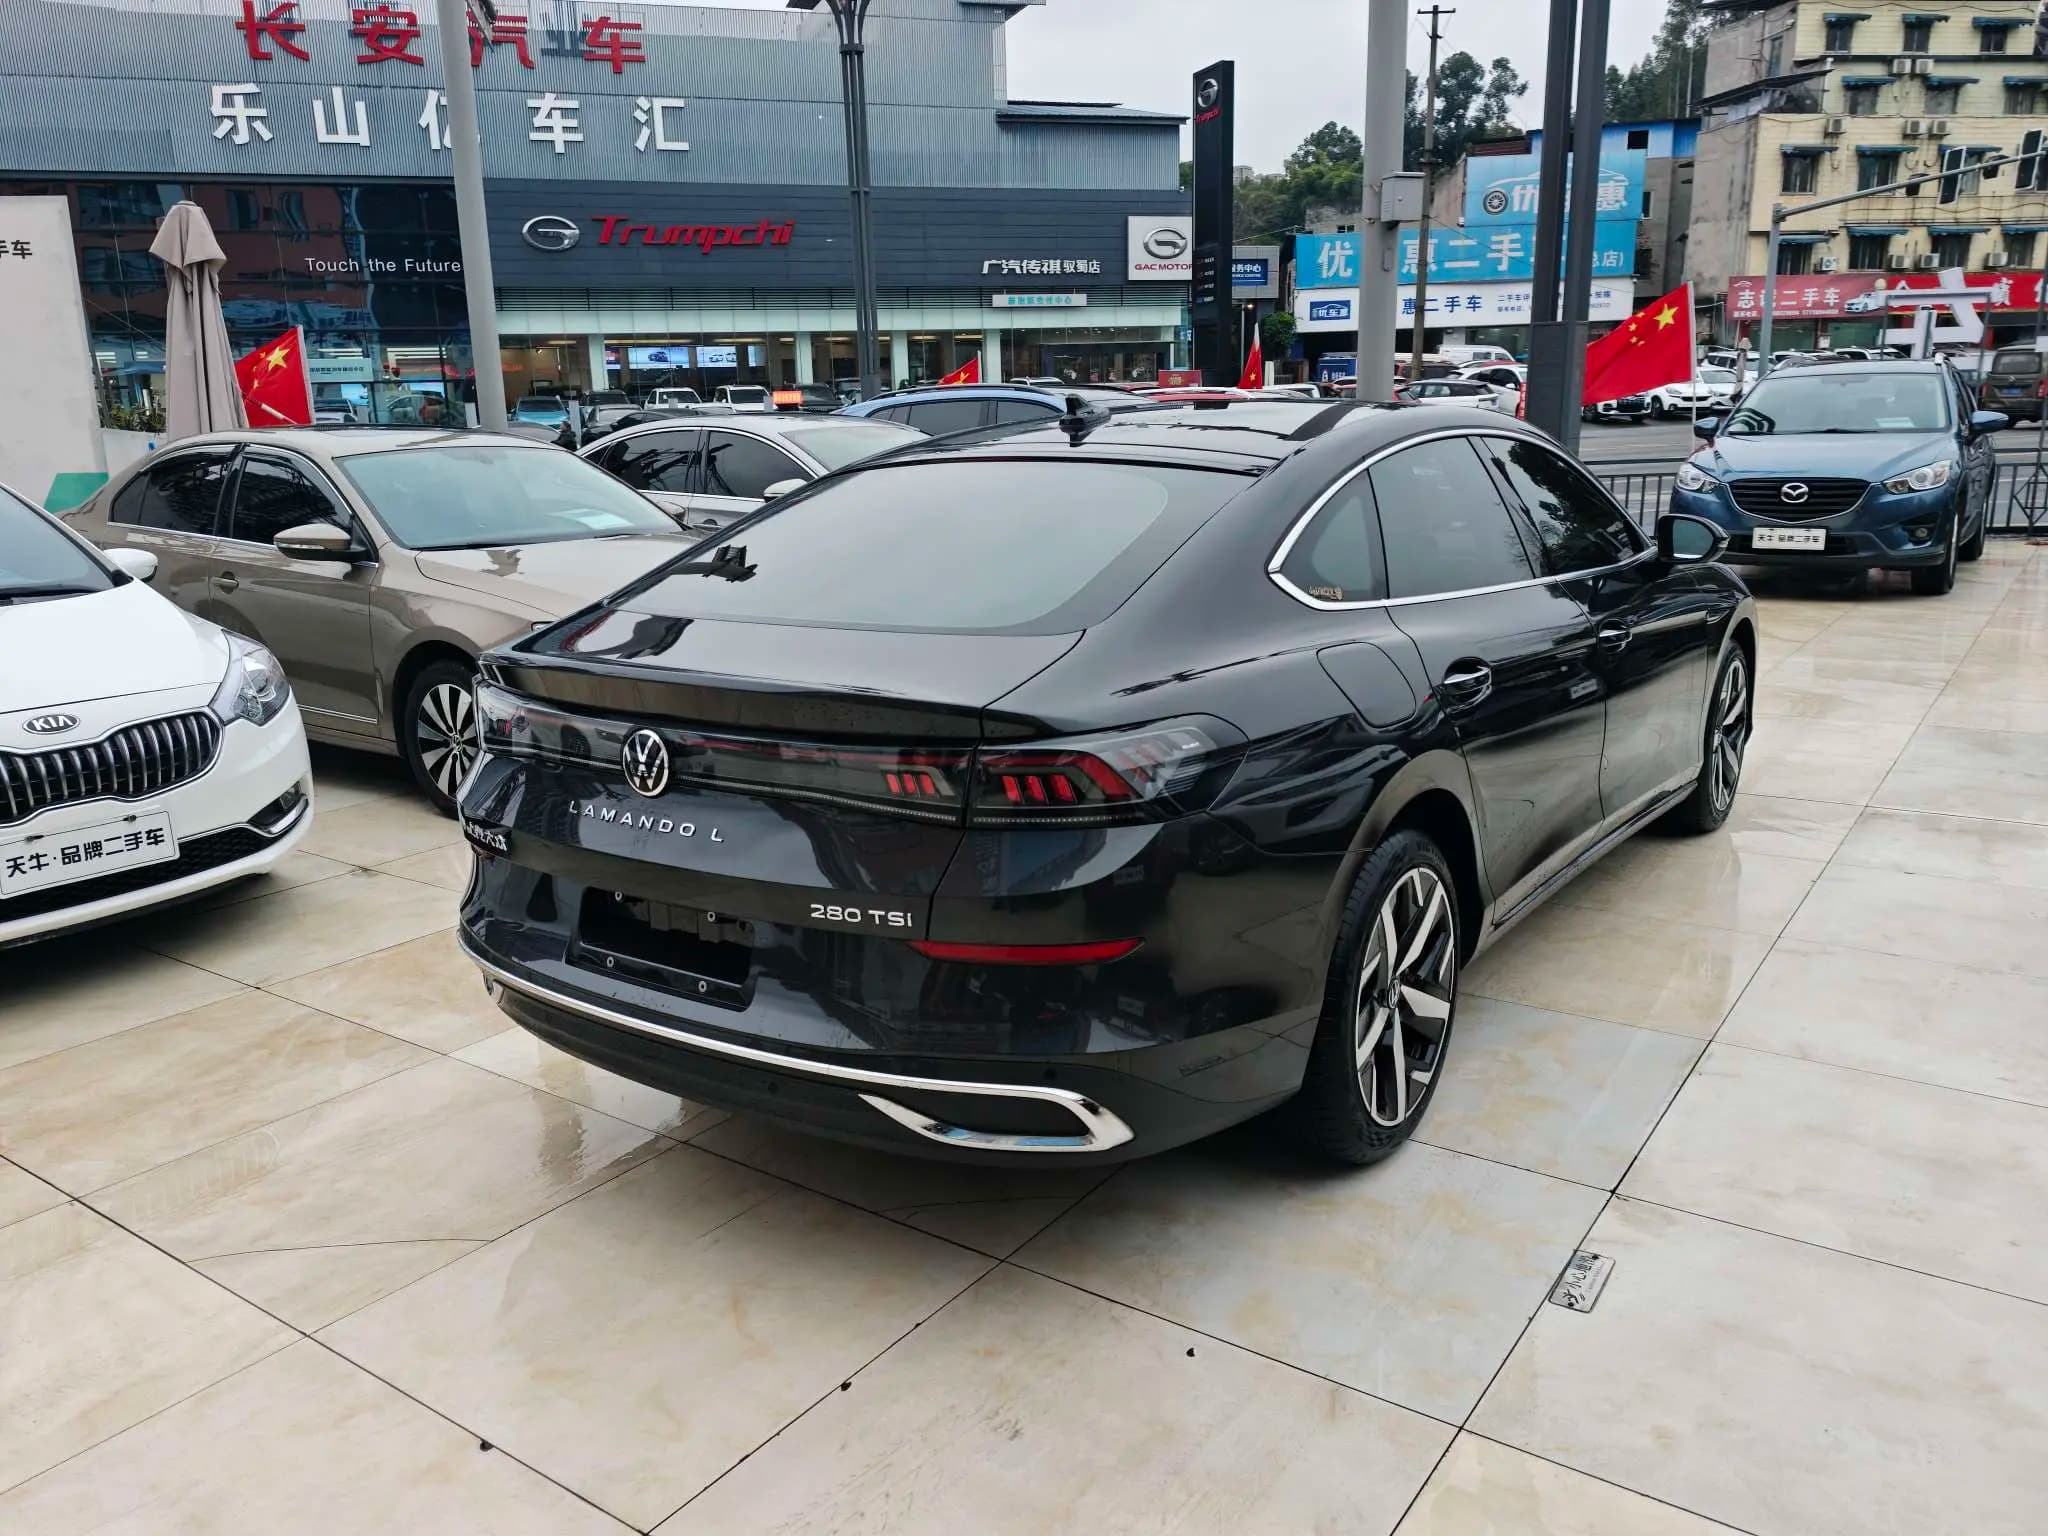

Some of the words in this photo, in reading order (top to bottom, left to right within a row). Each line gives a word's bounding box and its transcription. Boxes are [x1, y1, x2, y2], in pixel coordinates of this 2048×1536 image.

[592, 215, 796, 255] Trumpchi
[304, 258, 359, 272] Touch
[368, 259, 397, 272] the
[405, 258, 461, 272] Future
[1135, 263, 1157, 271] GAC
[32, 715, 73, 732] KIA
[569, 800, 696, 837] LAMANDO
[710, 818, 724, 843] L
[810, 903, 862, 923] 280
